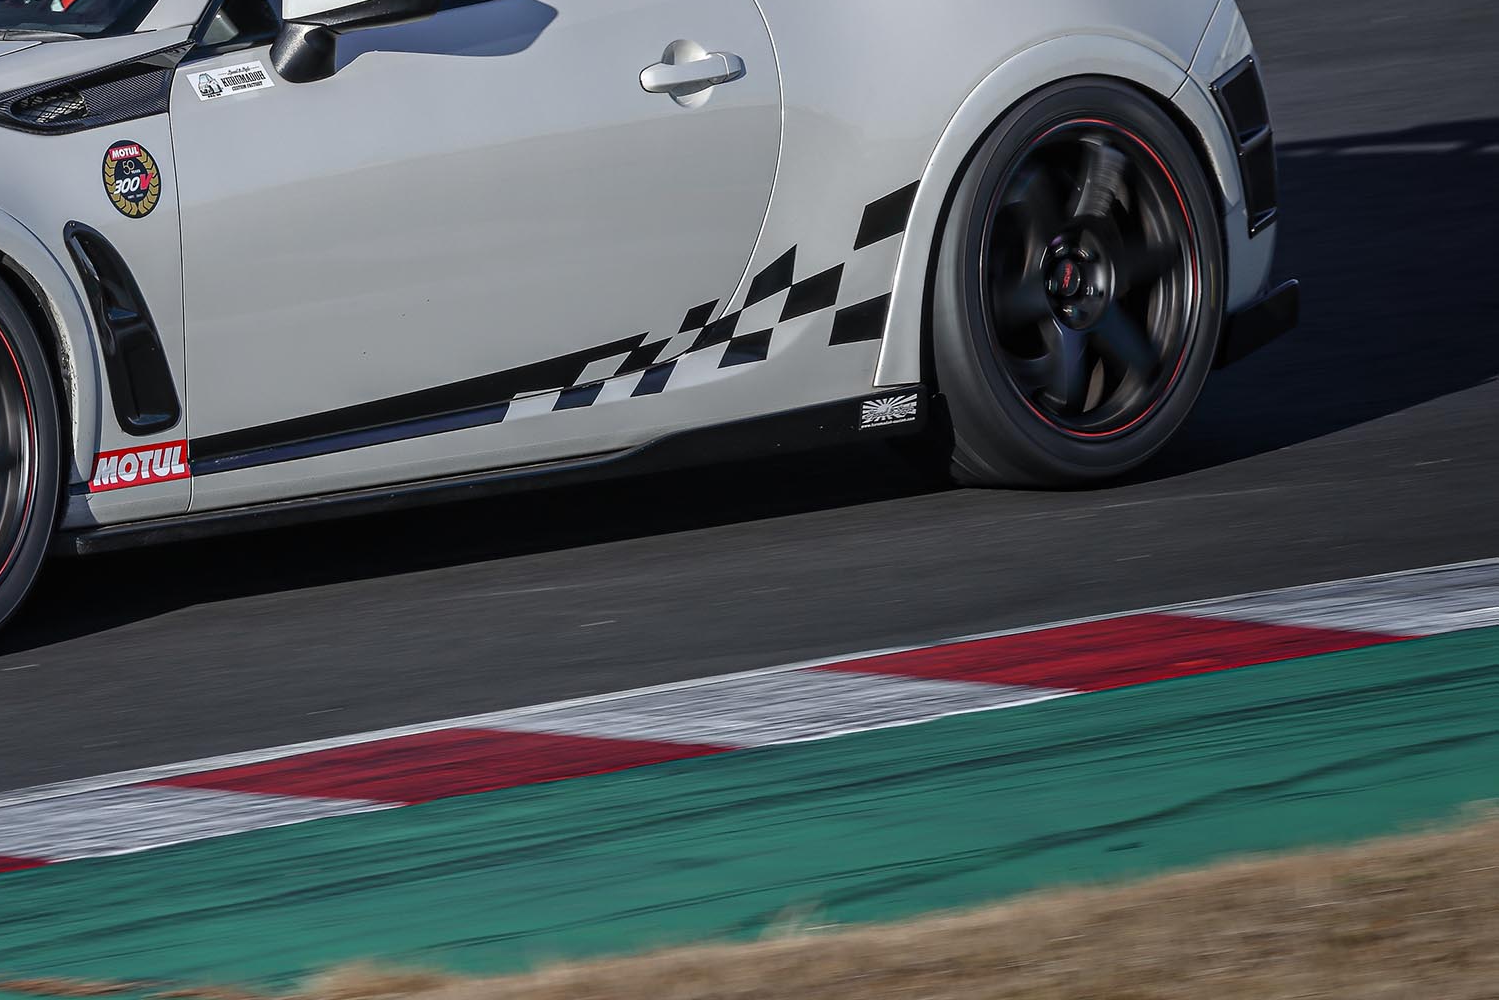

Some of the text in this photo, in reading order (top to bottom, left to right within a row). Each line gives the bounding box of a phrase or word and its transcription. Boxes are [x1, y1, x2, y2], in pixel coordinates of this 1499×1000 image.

[220, 70, 266, 88] KURUMADOH
[111, 146, 140, 159] MOTUL
[122, 160, 135, 175] 50
[114, 173, 154, 194] 300V
[93, 445, 185, 486] MOTUL
